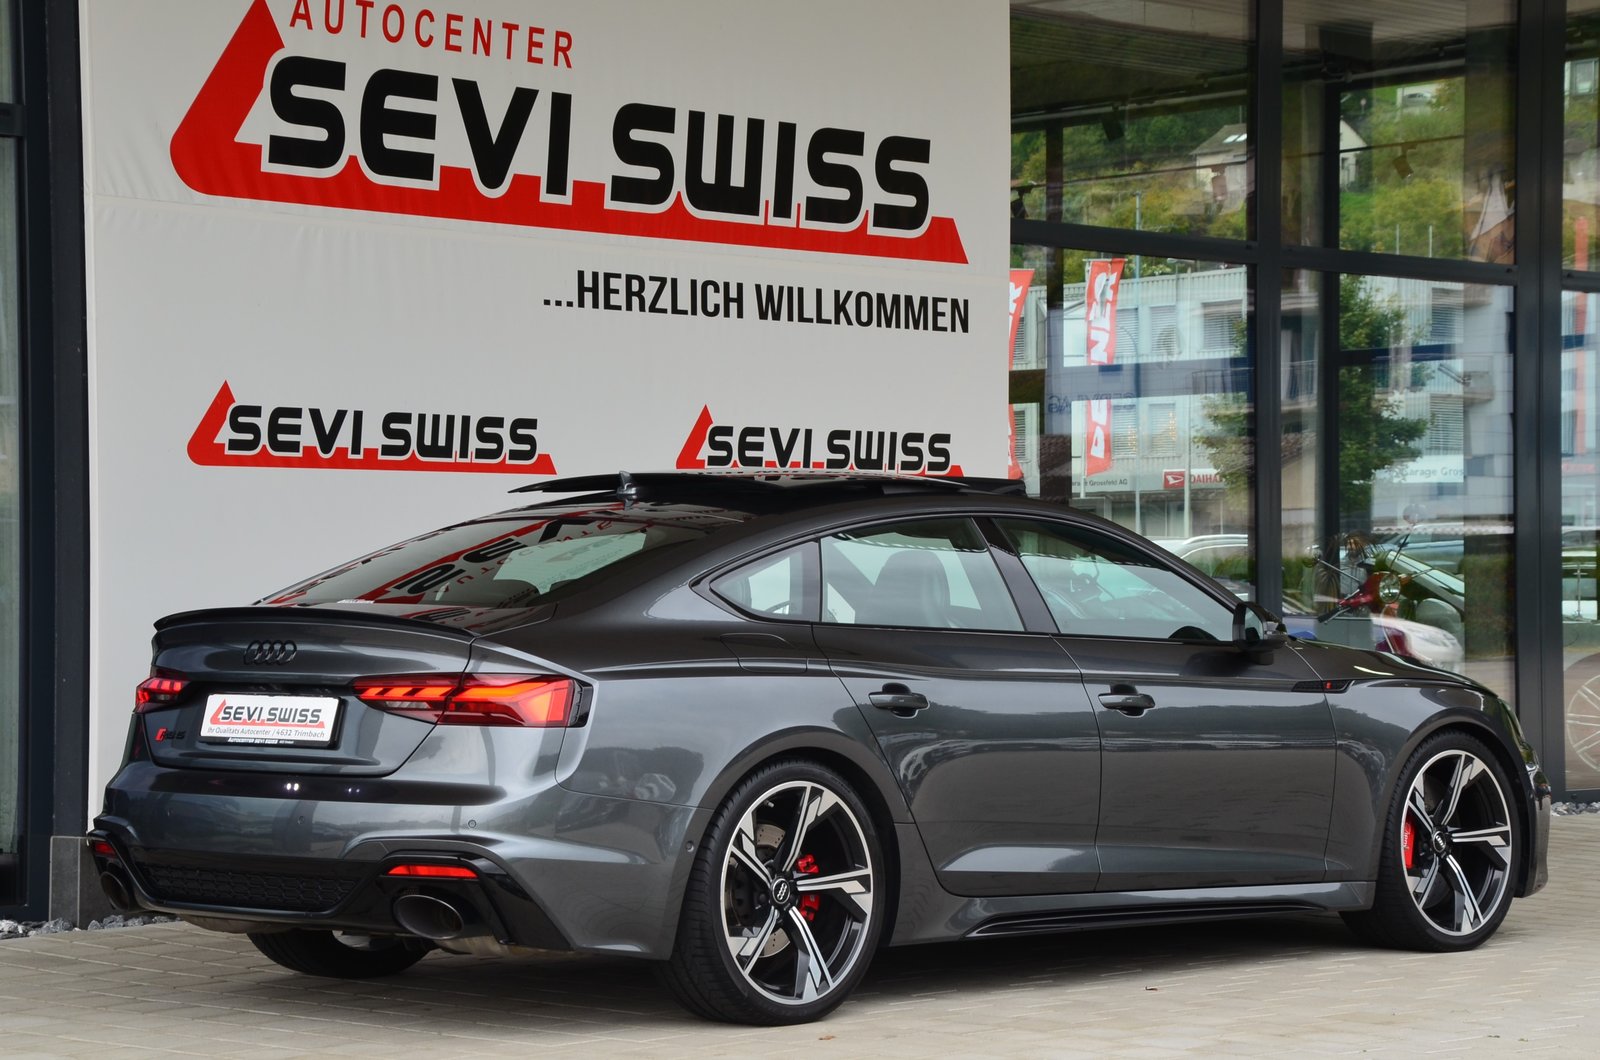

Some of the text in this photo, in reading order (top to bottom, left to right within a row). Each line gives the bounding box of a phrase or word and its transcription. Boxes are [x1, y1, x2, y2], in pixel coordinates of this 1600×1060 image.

[289, 0, 573, 68] AUTOCENTER
[269, 56, 930, 230] SEVI SWISS
[754, 284, 969, 334] WILLKOMMEN
[227, 405, 538, 461] SEVI SWISS
[707, 425, 951, 472] SEVI SWISS
[221, 705, 322, 724] SEVI SWISS
[240, 728, 271, 736] Autocenter
[294, 729, 325, 738] Trimbach
